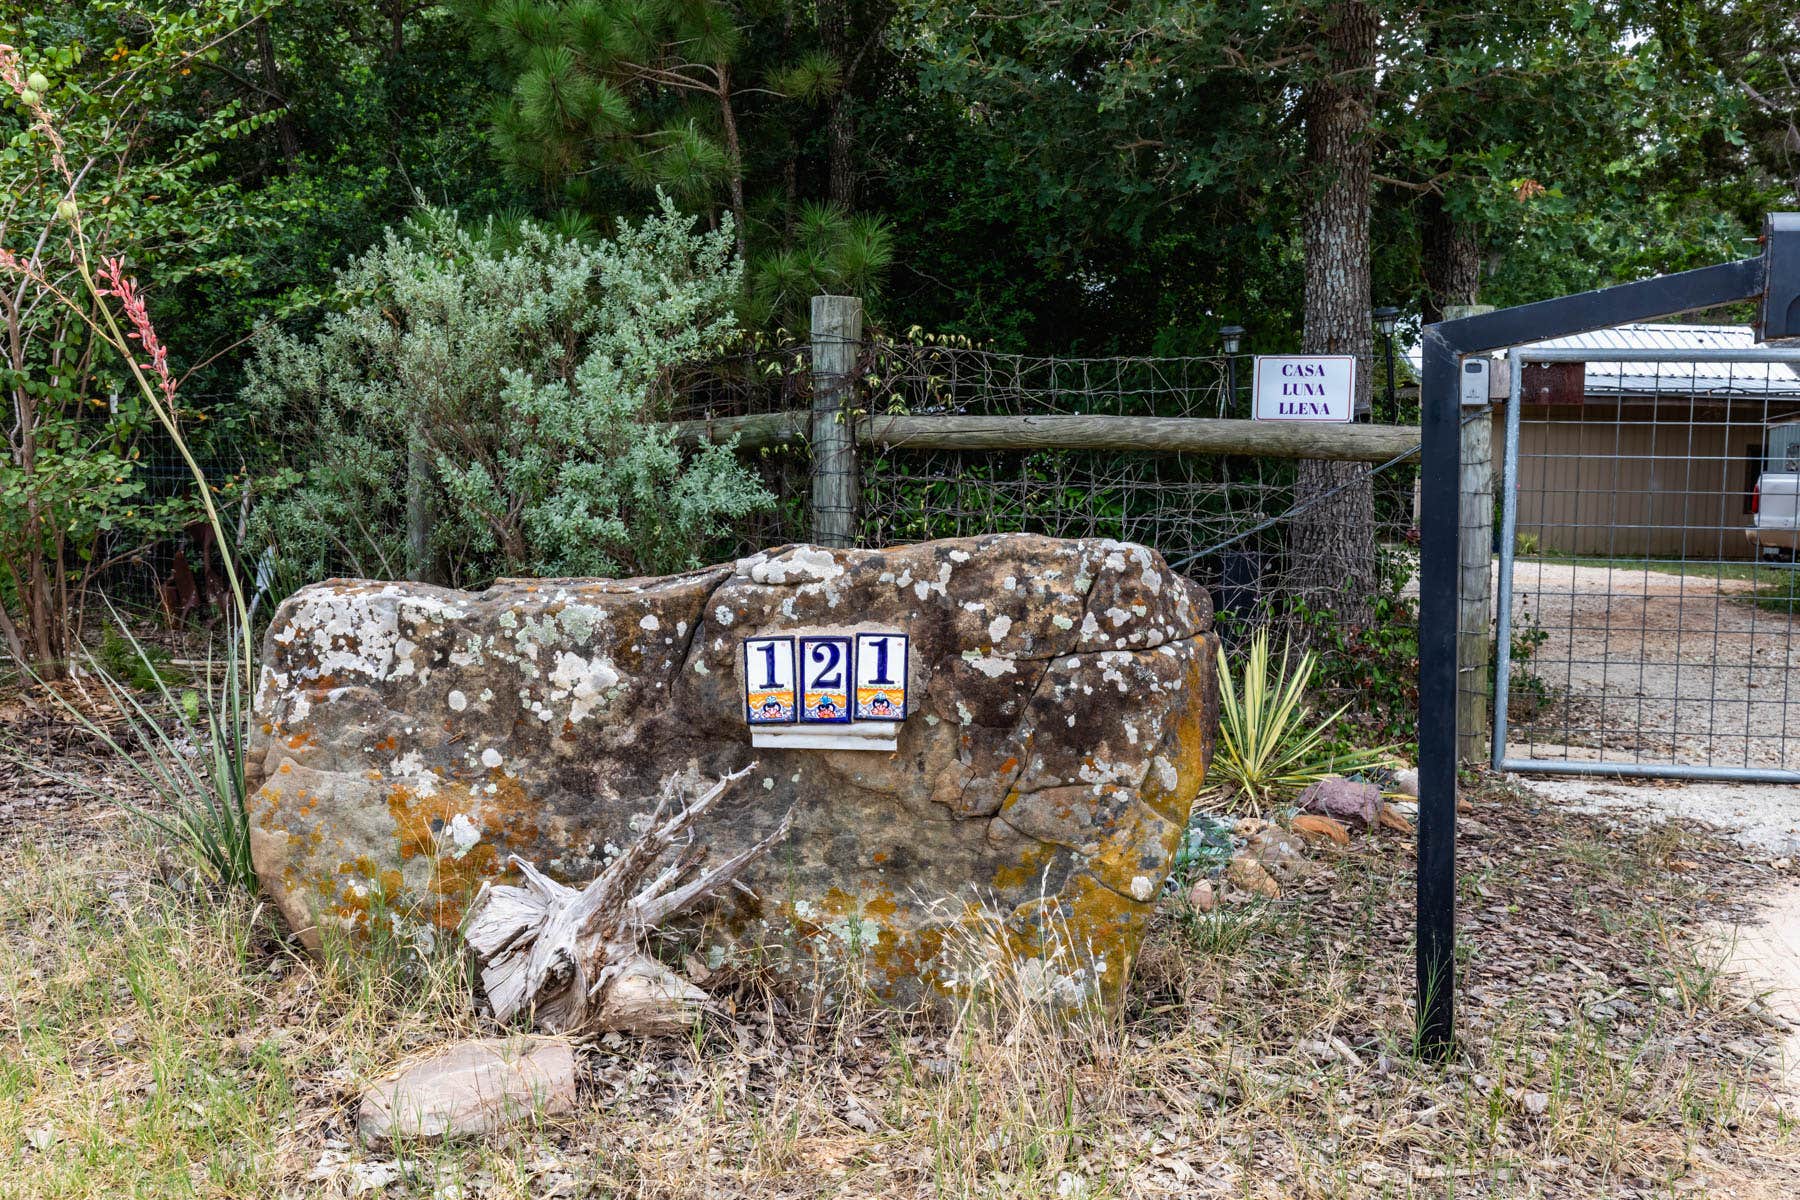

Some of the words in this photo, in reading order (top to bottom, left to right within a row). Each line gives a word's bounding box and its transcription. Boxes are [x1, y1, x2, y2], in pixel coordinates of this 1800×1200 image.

[1282, 364, 1325, 377] CASA
[1283, 383, 1325, 396] LUNA
[1279, 402, 1330, 415] LLENA
[756, 637, 895, 689] 121
